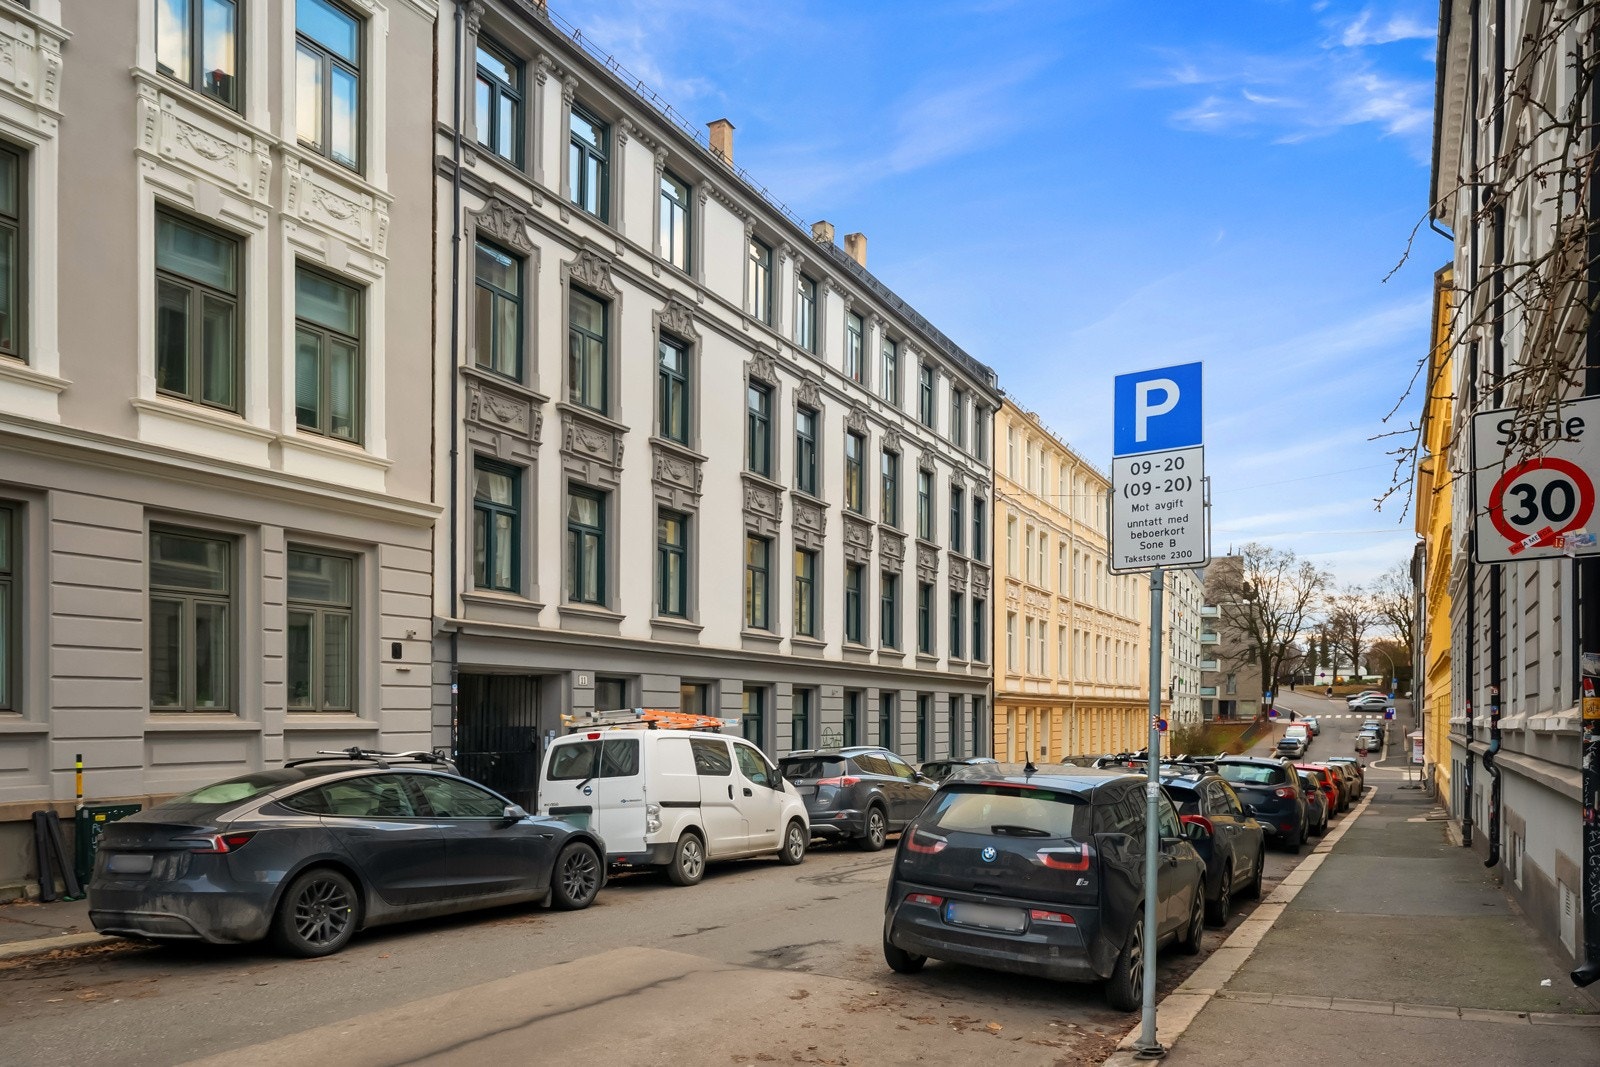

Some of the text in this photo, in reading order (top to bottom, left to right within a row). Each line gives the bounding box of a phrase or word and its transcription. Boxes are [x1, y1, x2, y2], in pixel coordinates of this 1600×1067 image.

[1135, 378, 1181, 443] P
[1496, 416, 1585, 446] Sone
[1131, 499, 1184, 513] Mot avgift
[1509, 479, 1576, 526] 30
[1127, 514, 1189, 529] unntatt med
[1130, 527, 1185, 540] beboerkort
[1139, 538, 1177, 550] Sone B
[1124, 550, 1193, 564] Takstsone 2300
